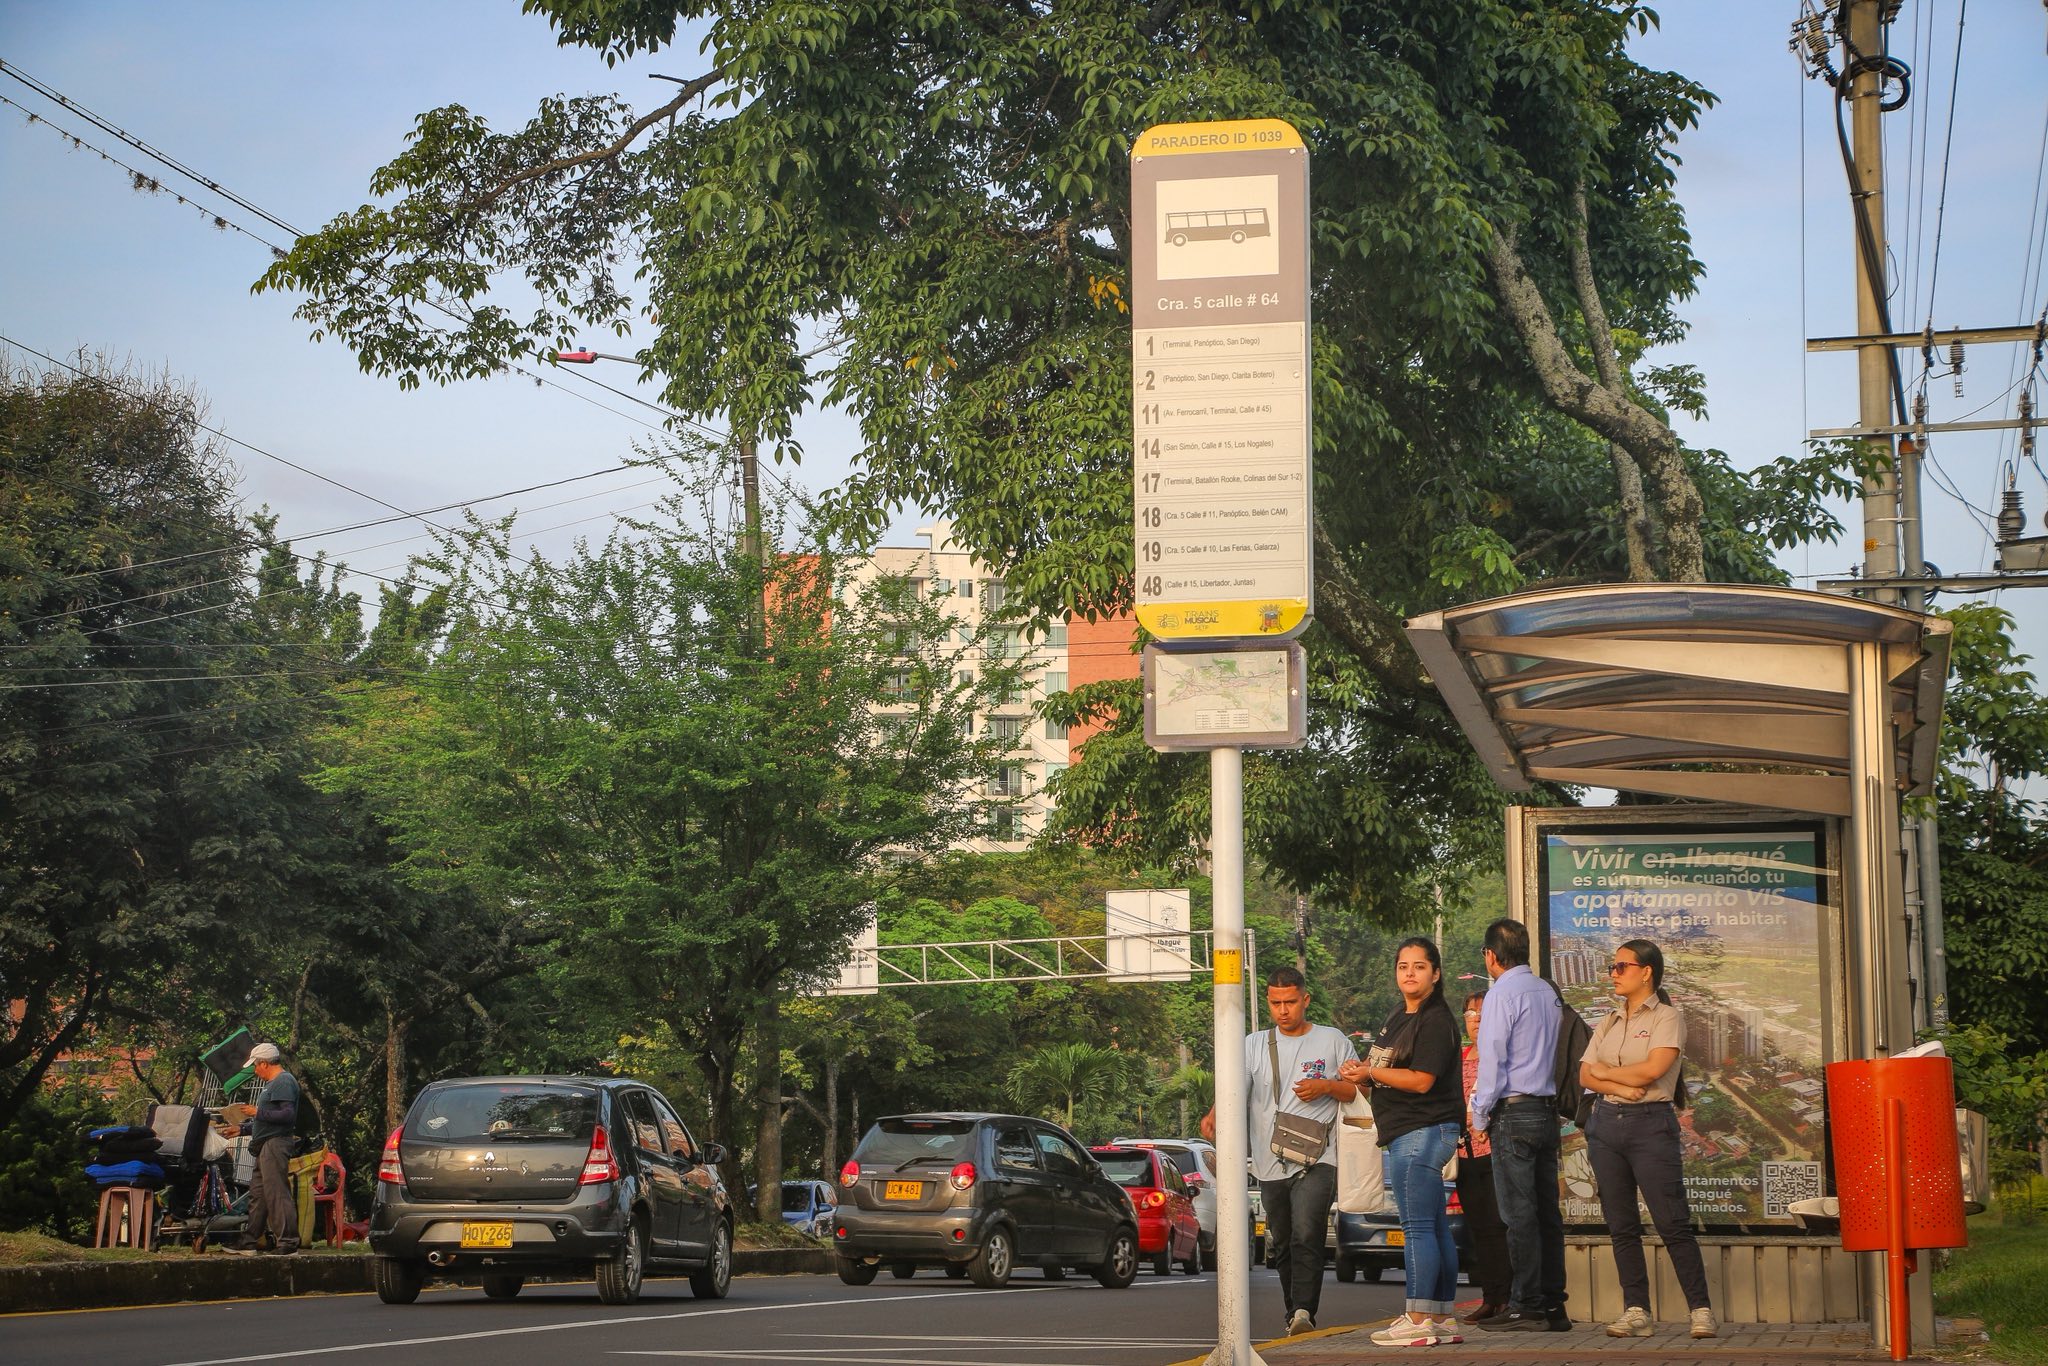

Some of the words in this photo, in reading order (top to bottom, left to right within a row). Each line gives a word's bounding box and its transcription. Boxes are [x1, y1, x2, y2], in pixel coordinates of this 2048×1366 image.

[1151, 134, 1229, 148] PARADERO
[1234, 132, 1247, 144] ID
[1252, 131, 1282, 142] 1039
[1158, 298, 1188, 310] Cra.
[1194, 296, 1202, 309] 5
[1207, 294, 1243, 308] calle
[1247, 294, 1256, 306] #
[1261, 292, 1279, 306] 64
[1146, 336, 1154, 356] 1
[1240, 337, 1260, 346] Diego)
[1146, 370, 1155, 390] 2
[1252, 370, 1275, 379] Botero)
[1142, 404, 1159, 424] 11
[1210, 407, 1238, 415] Terminal,
[1261, 405, 1272, 413] 45)
[1142, 438, 1160, 459] 14
[1164, 443, 1178, 452] (San
[1201, 442, 1217, 450] Calle
[1224, 441, 1233, 449] 15,
[1247, 440, 1274, 449] Nogales)
[1142, 473, 1161, 493] 17
[1164, 478, 1194, 487] (Terminal,
[1142, 507, 1161, 527] 18
[1164, 512, 1179, 521] (Cra.
[1186, 511, 1201, 519] Calle
[1208, 511, 1218, 519] 11,
[1252, 508, 1269, 517] Belén
[1271, 507, 1288, 516] CAM)
[1143, 542, 1162, 562] 19
[1165, 547, 1179, 555] (Cra.
[1186, 546, 1201, 554] Calle
[1209, 545, 1218, 553] 10,
[1254, 542, 1279, 552] Galarza)
[1143, 576, 1162, 596] 48
[1165, 580, 1183, 589] (Calle
[1189, 580, 1199, 588] 15,
[1200, 579, 1232, 587] Libertador,
[1233, 578, 1255, 586] Juntas)
[1572, 848, 1635, 870] Vivir
[1642, 850, 1676, 868] en
[1685, 846, 1786, 872] Ibagué
[1572, 874, 1592, 887] es
[1600, 872, 1630, 886] aún
[1636, 870, 1687, 888] mejor
[1693, 870, 1761, 886] cuando
[1766, 870, 1785, 884] tu
[1573, 890, 1738, 912] apartamento
[1748, 888, 1786, 906] VIS
[1573, 914, 1622, 928] viene
[1627, 912, 1665, 926] listo
[1670, 913, 1711, 930] para
[1716, 911, 1787, 926] habitar.
[905, 1184, 919, 1195] 481
[1683, 1176, 1758, 1186] artamentos
[1686, 1188, 1732, 1201] Ibagué
[1688, 1202, 1747, 1212] minados.
